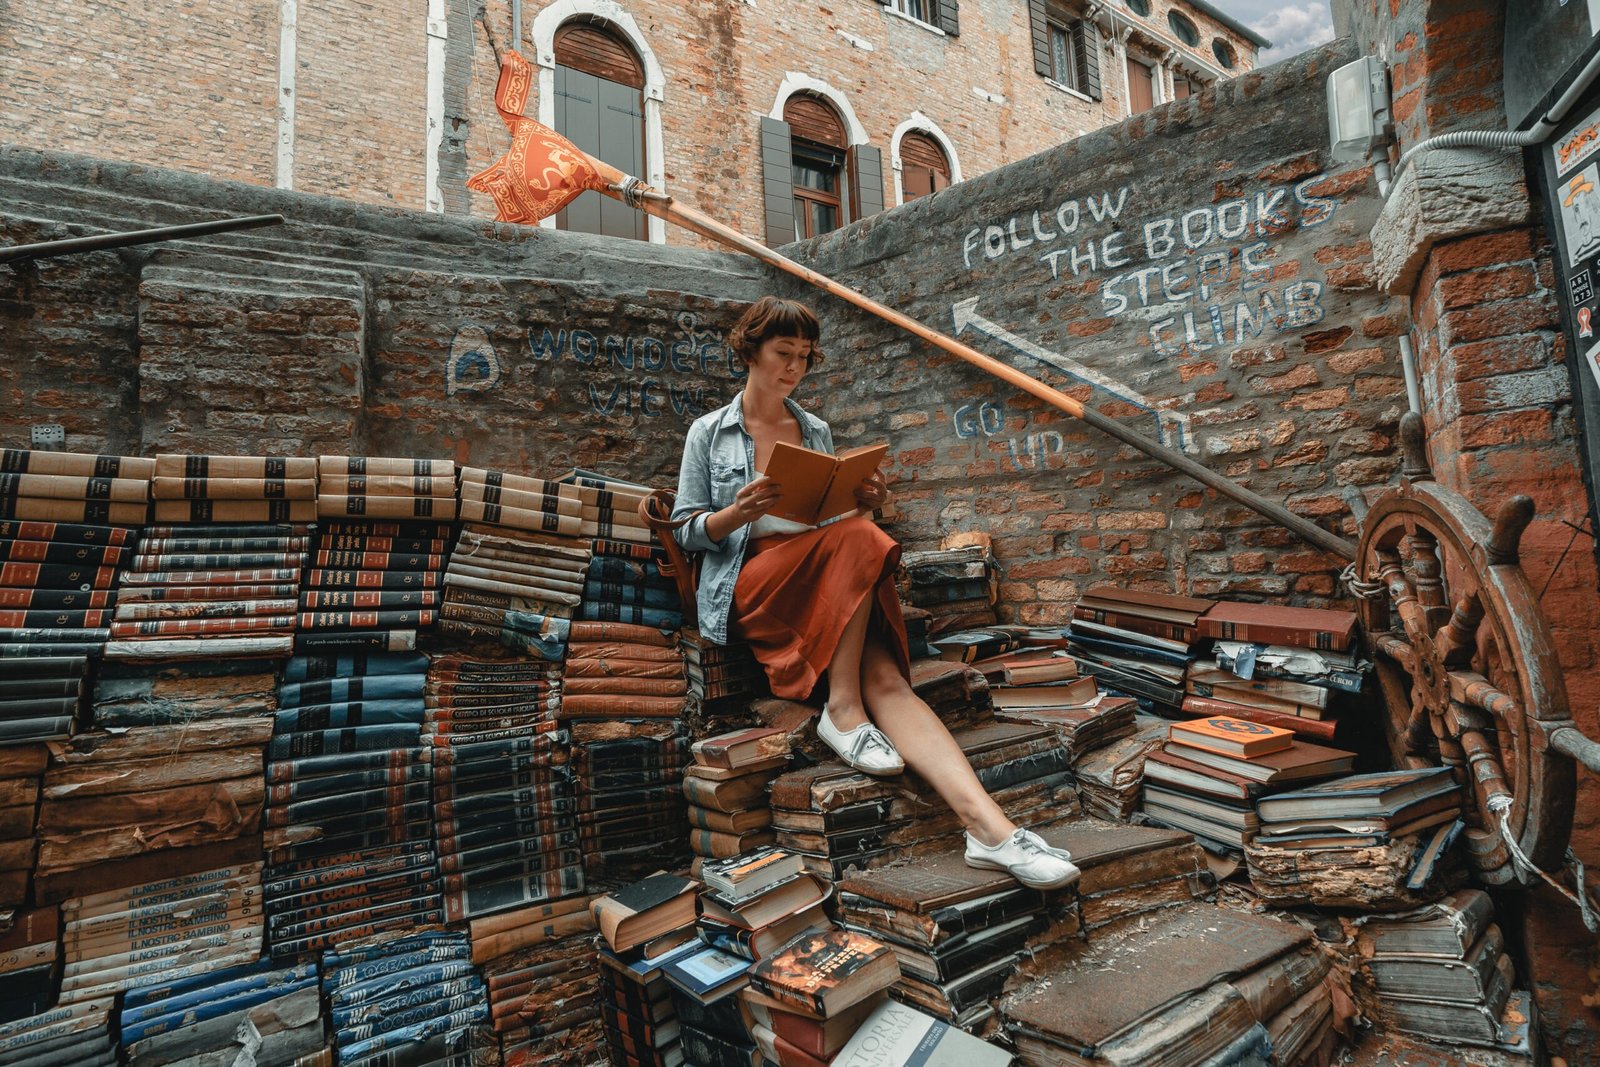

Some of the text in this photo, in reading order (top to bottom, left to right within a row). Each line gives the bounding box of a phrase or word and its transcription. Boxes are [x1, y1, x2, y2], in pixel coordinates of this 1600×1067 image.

[963, 188, 1128, 269] FOLLOW
[1040, 174, 1338, 280] THE BOOKS
[1101, 241, 1274, 318] STEPS
[1571, 273, 1588, 287] ART
[1573, 282, 1589, 294] HOUSE
[1575, 289, 1591, 302] 473
[1149, 281, 1324, 357] CLIMB
[588, 378, 704, 417] VIEW
[953, 402, 1005, 439] GO
[1008, 430, 1064, 471] UP
[1329, 674, 1354, 686] CURCIO
[180, 882, 225, 900] BAMBIN
[306, 936, 325, 950] LA
[328, 925, 375, 944] CUCINA
[870, 1013, 916, 1067] NIVERSALE
